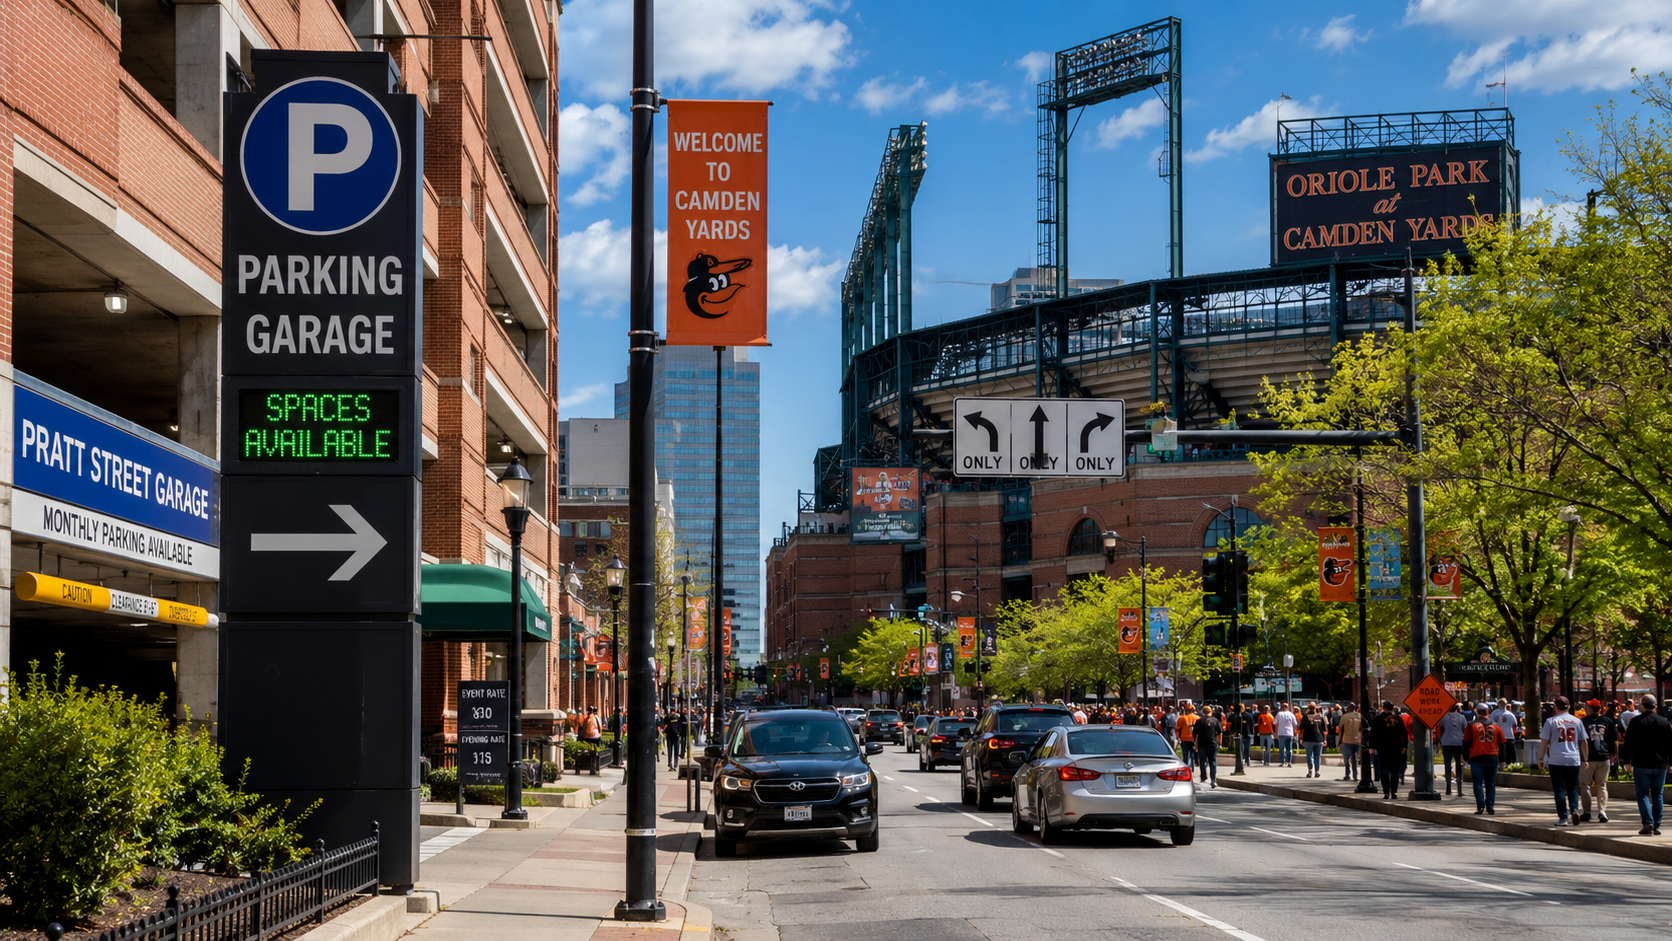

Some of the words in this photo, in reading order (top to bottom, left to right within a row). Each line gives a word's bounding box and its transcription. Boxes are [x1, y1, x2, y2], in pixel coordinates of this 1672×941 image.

[674, 132, 763, 153] WELCOME
[288, 102, 373, 211] P
[705, 161, 731, 182] TO
[1286, 166, 1396, 198] ORIOLE
[1409, 159, 1490, 188] PARK
[675, 190, 761, 211] CAMDEN
[1373, 192, 1401, 214] at
[685, 219, 751, 240] YARDS
[1283, 219, 1396, 251] CAMDEN
[1406, 213, 1495, 241] YARDS
[238, 254, 403, 296] PARKING
[246, 313, 394, 355] GARAGE
[266, 393, 371, 422] SPACES
[245, 429, 391, 457] AVAILABLE
[21, 418, 86, 477] PRATT
[90, 446, 152, 500] STREET
[154, 472, 209, 520] GARAGE
[963, 455, 1003, 470] ONLY
[1075, 456, 1115, 470] ONLY
[43, 504, 99, 543] MONTHLY
[102, 522, 145, 555] PARKING
[147, 529, 193, 566] AVAILABLE
[62, 583, 93, 604] CAUTION
[461, 688, 485, 699] EVENT
[486, 688, 506, 699] RATE
[1419, 687, 1440, 696] ROAD
[1418, 707, 1443, 715] AHEAD
